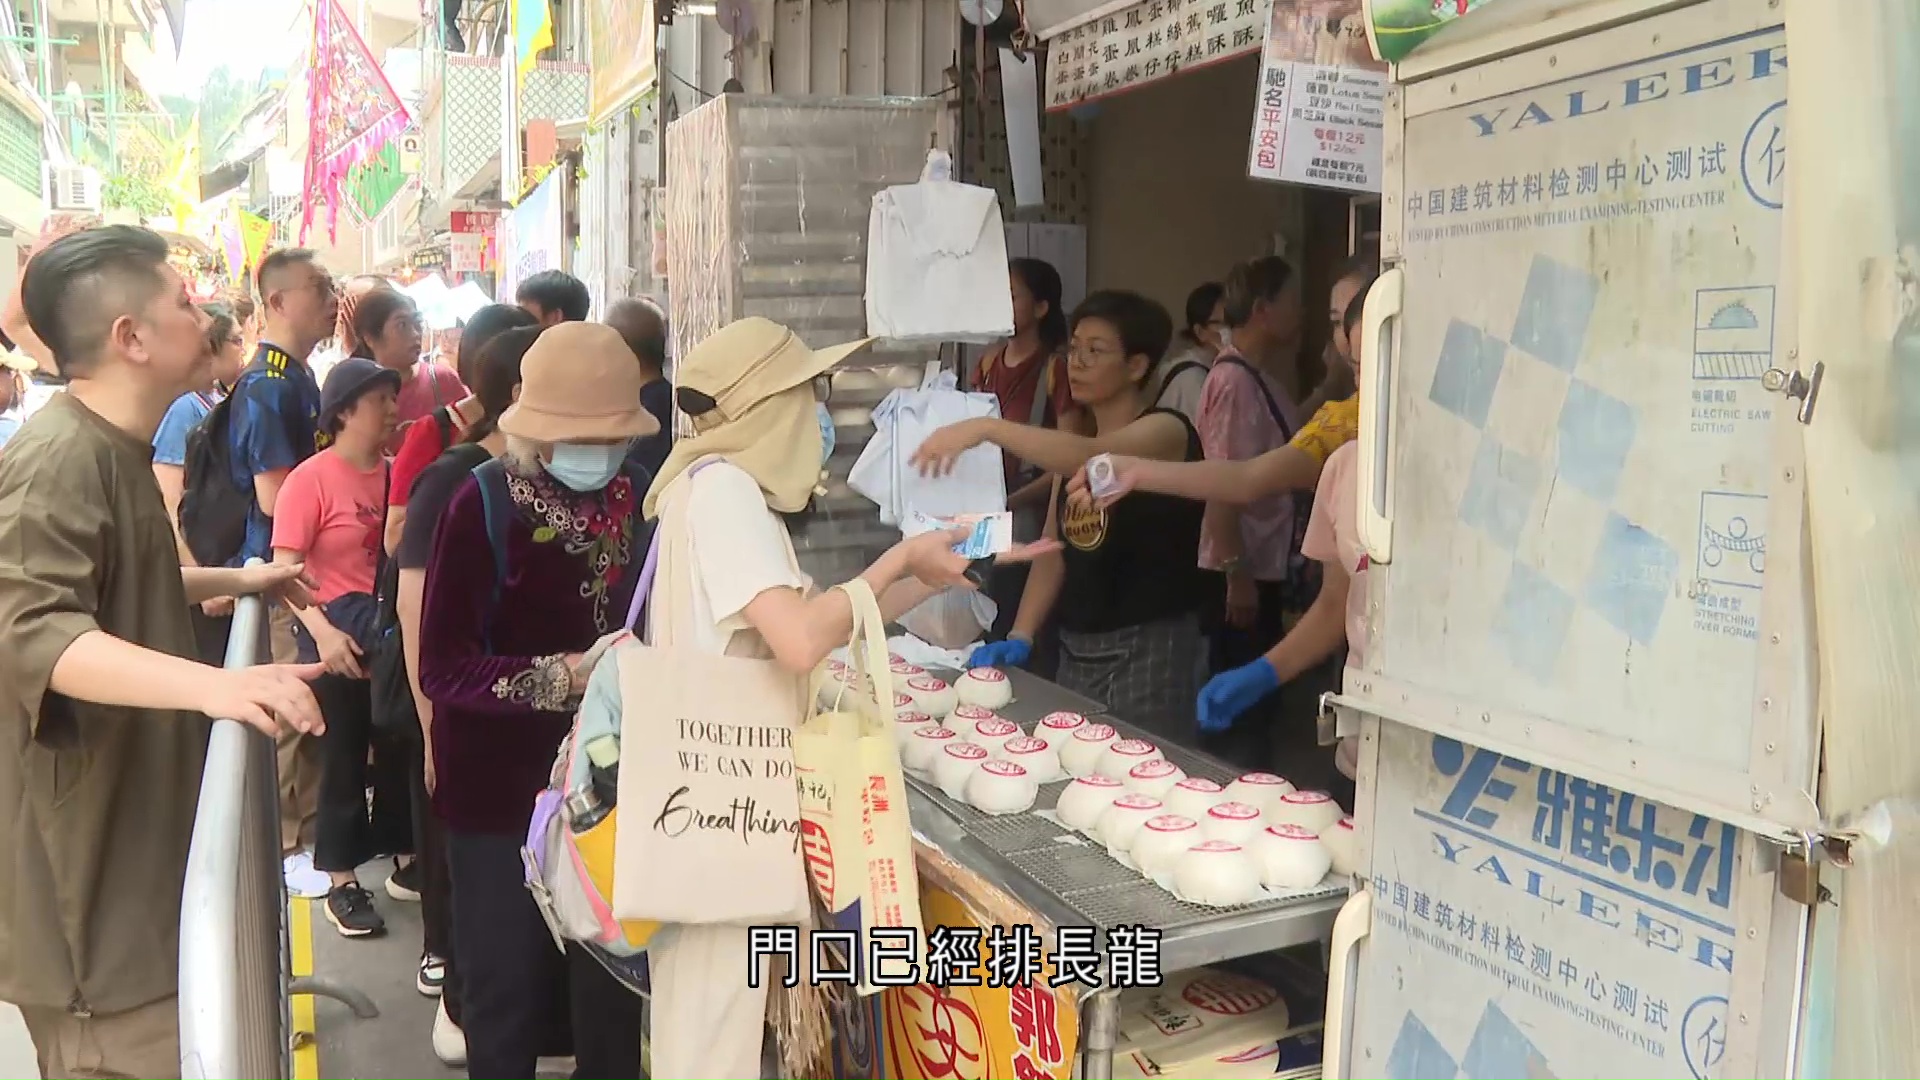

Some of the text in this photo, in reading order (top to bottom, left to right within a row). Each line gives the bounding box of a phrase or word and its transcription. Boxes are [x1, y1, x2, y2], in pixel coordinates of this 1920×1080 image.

[1257, 68, 1286, 169] 馳名平安包
[1407, 141, 1727, 220] 中国建筑材料检测中心测试
[1681, 190, 1725, 209] CENTER
[1691, 407, 1741, 419] ELECTRIC
[676, 718, 793, 749] TOGETHER
[678, 751, 793, 779] WE CAN DO
[1374, 874, 1669, 1032] 中国建筑材料检测中心测试
[1623, 1029, 1665, 1058] CENTER
